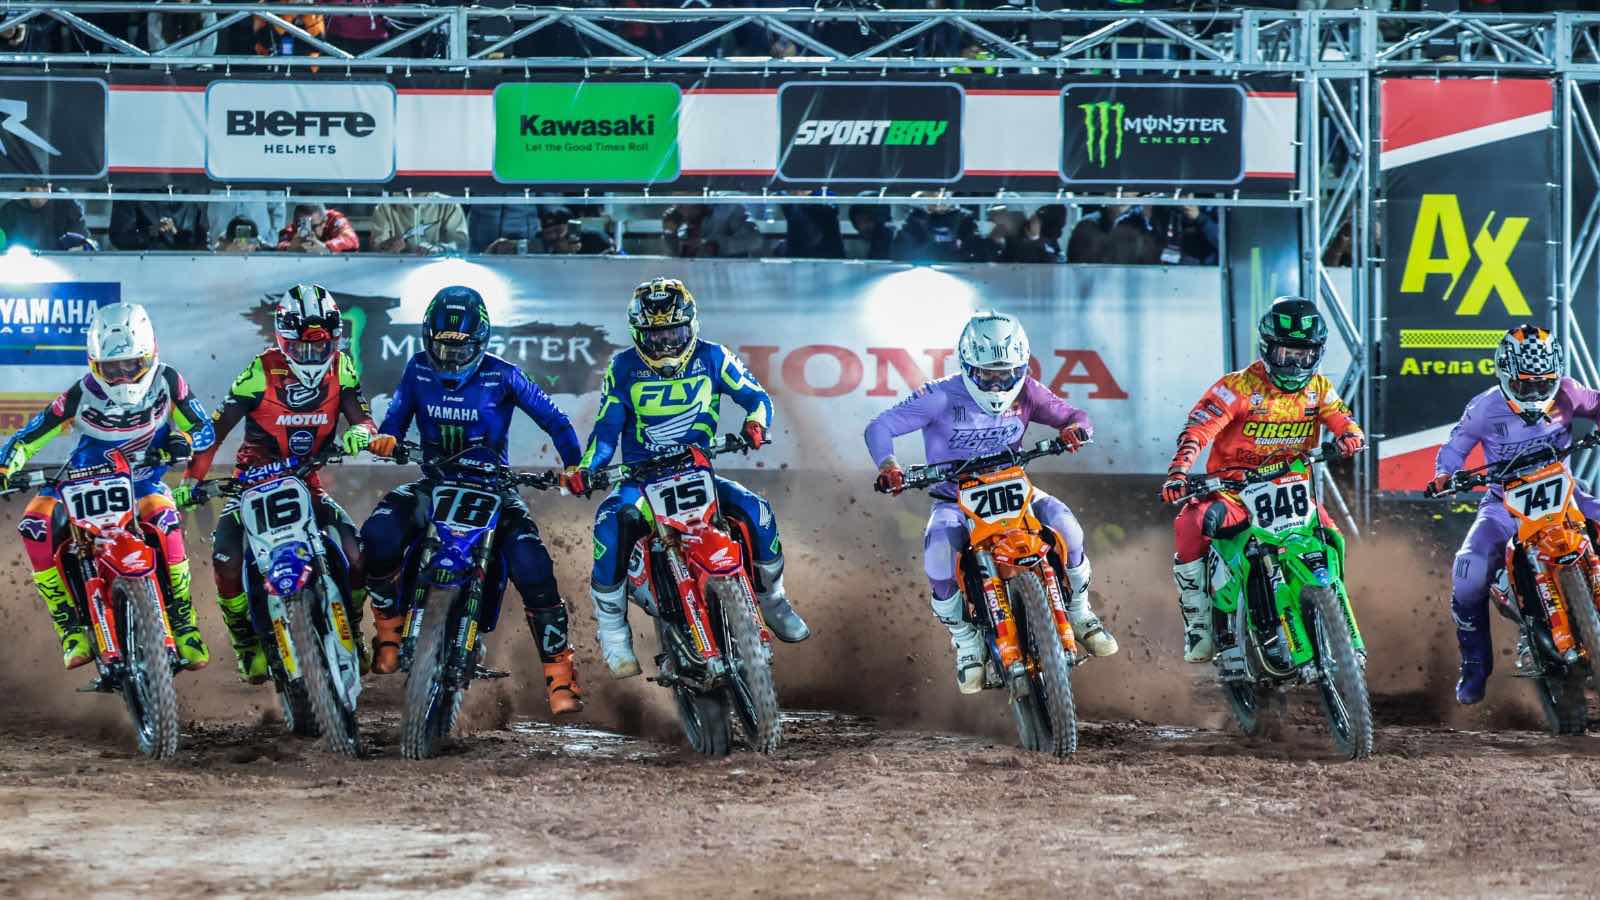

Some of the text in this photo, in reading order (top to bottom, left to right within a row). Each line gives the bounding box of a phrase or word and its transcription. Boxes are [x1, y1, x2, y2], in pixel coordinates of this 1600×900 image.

[520, 114, 655, 137] Kawasaki
[793, 120, 948, 145] SPORTBAY
[1124, 115, 1228, 134] MONSTER
[264, 144, 336, 155] HELMETS
[525, 142, 649, 152] Let the Good Times Roll
[1139, 136, 1213, 144] ENERGY
[1400, 194, 1533, 316] AX
[0, 298, 98, 324] YAMAHA
[1400, 357, 1475, 375] Arena
[640, 379, 705, 408] FLY
[275, 413, 328, 426] MOTUL
[426, 404, 479, 421] YAMAHA
[71, 486, 131, 520] 109
[434, 490, 497, 528] 18
[659, 479, 708, 517] 15
[970, 483, 1025, 518] 206
[1254, 484, 1309, 529] 848
[1515, 478, 1563, 516] 747
[250, 488, 302, 535] 16
